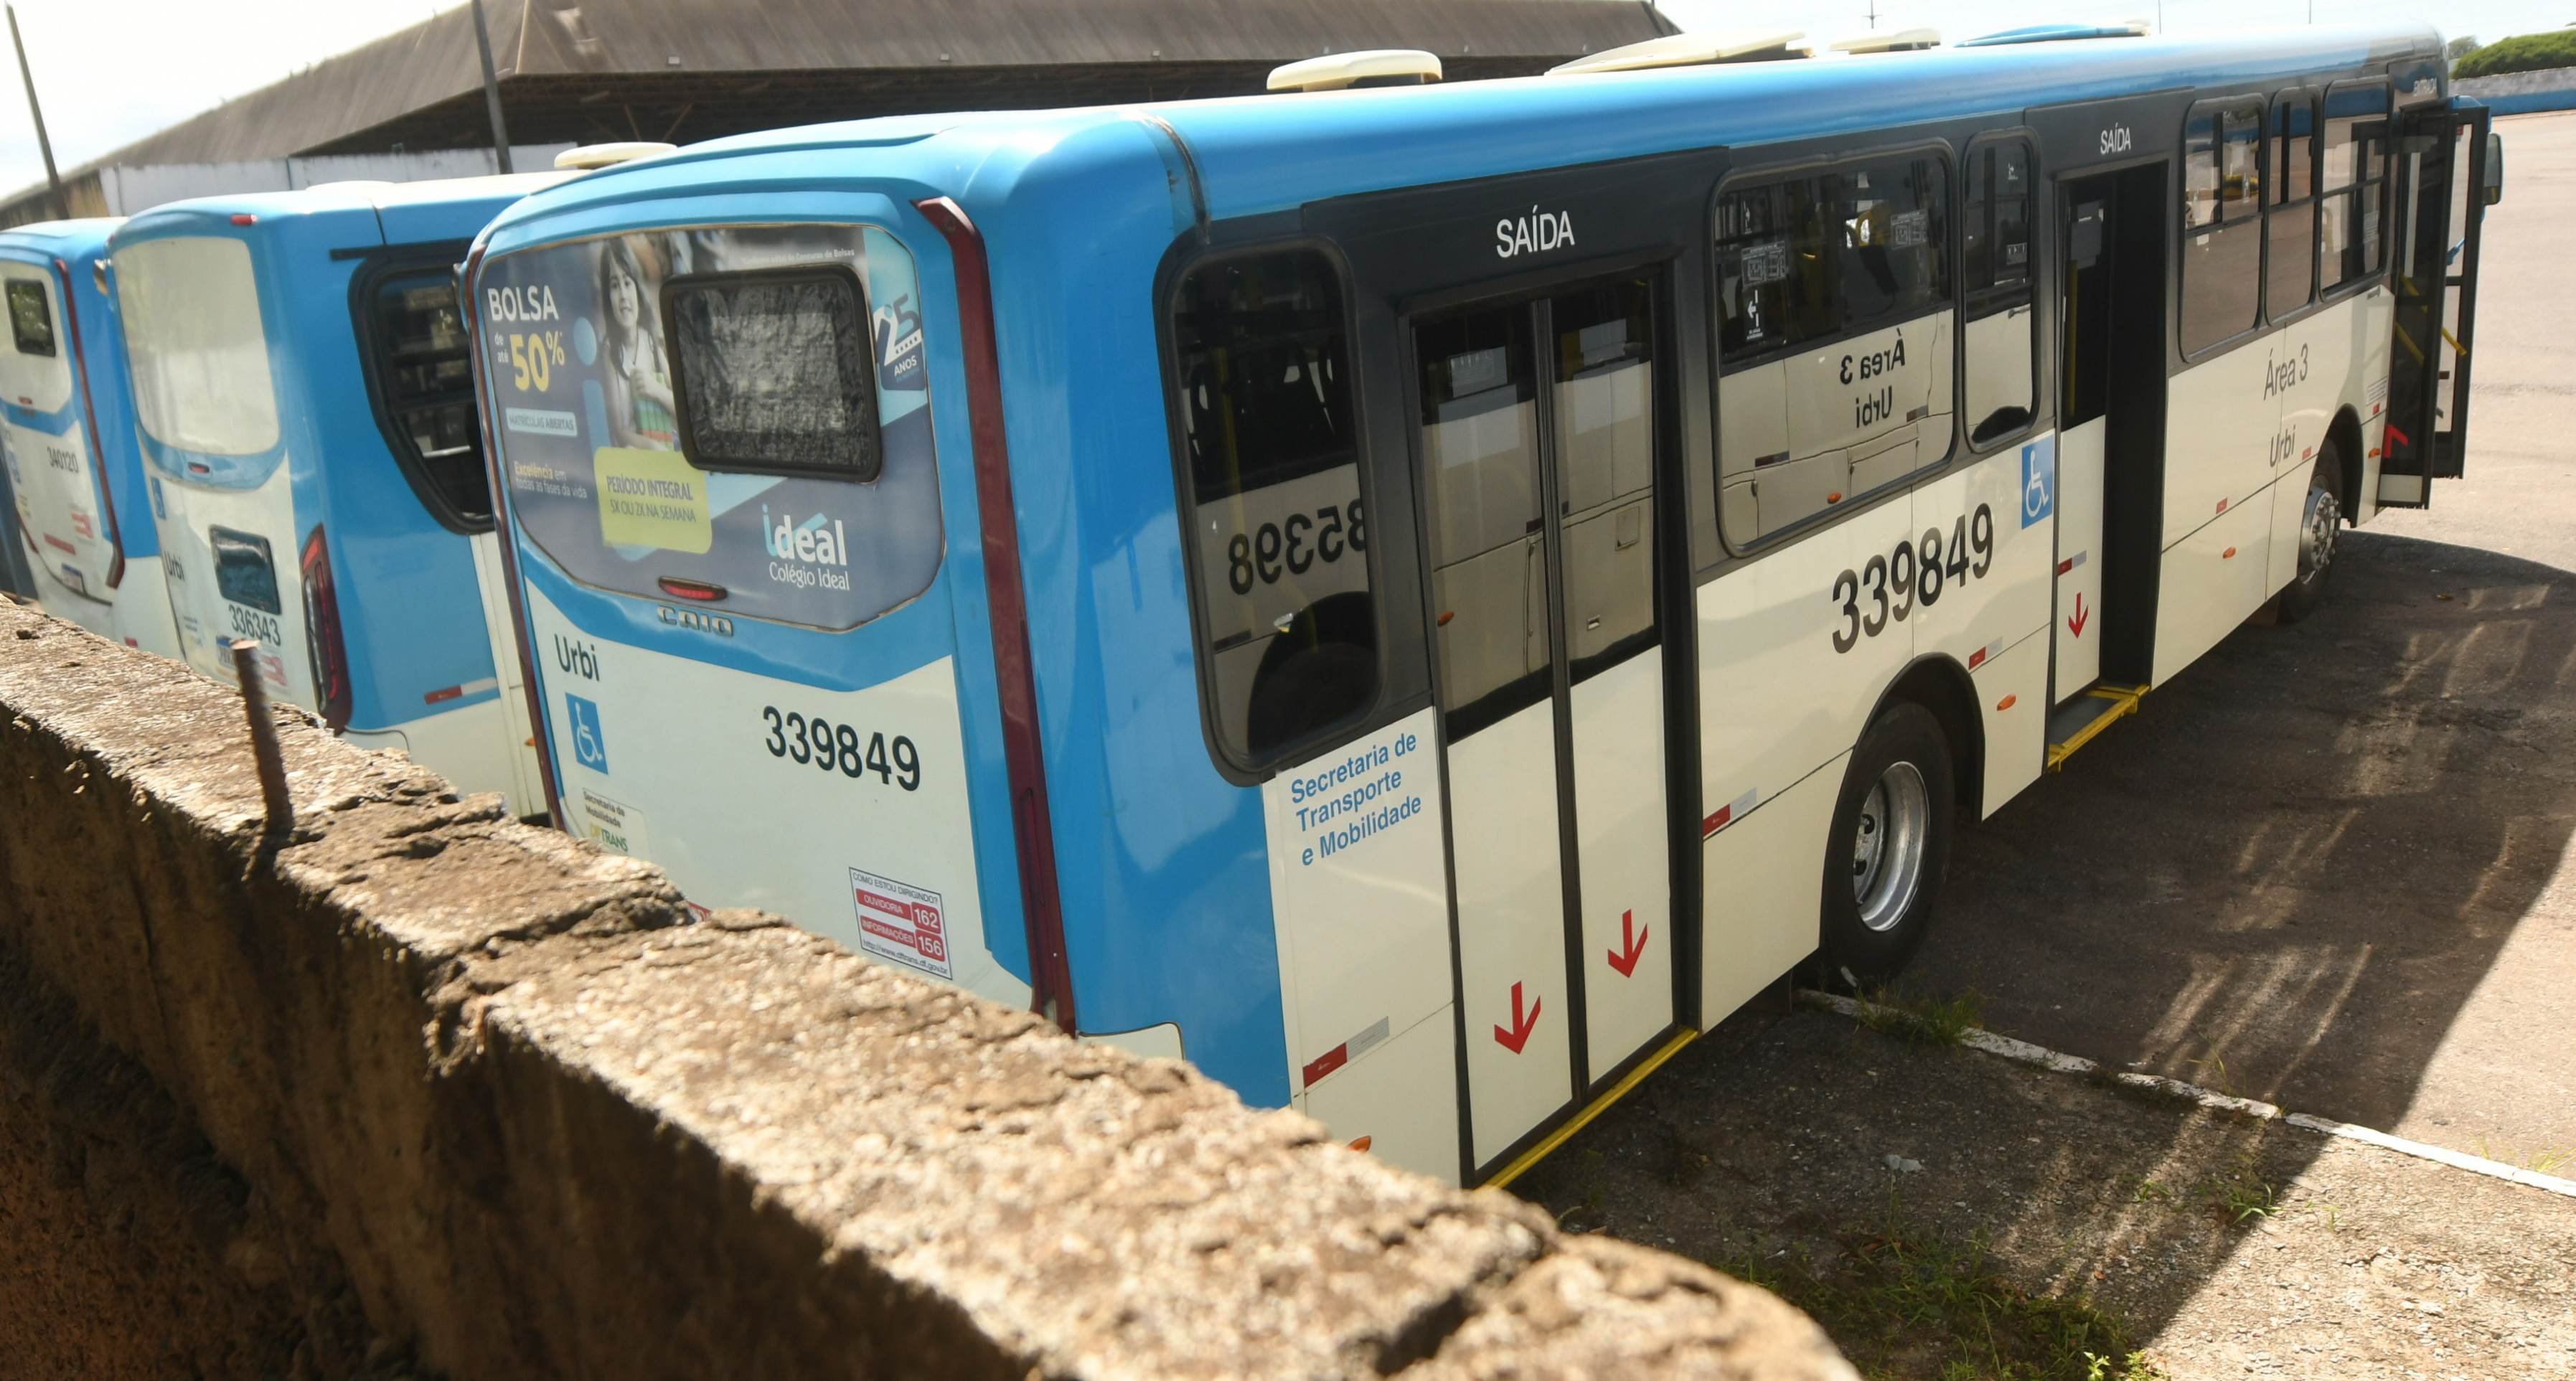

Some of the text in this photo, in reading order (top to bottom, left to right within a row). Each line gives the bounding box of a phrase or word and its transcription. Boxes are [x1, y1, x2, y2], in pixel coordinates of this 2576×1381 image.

[2100, 122, 2131, 155] SAÍDA
[1496, 204, 1575, 258] SAÍDA
[834, 248, 855, 258] Bolsas
[487, 285, 559, 321] BOLSA
[494, 331, 504, 346] de
[497, 349, 509, 363] até
[894, 355, 918, 377] ANOS
[2263, 343, 2308, 402] Área 3
[545, 418, 574, 431] ABERTAS
[46, 446, 79, 473] 340120
[2269, 424, 2296, 468] Urbi
[606, 473, 694, 501] PERÍODO INTEGRAL
[622, 499, 634, 514] OU
[647, 504, 659, 518] NA
[662, 504, 697, 523] SEMANA
[762, 504, 847, 566] ideal
[164, 550, 185, 582] Urbi
[768, 562, 850, 591] Colégio Ideal
[1832, 503, 1993, 654] 339849
[228, 603, 281, 646] 336343
[657, 605, 734, 638] CAIO
[554, 633, 601, 682] Urbi
[763, 705, 921, 791] 339849
[1292, 733, 1416, 803] Secretaria de
[583, 791, 625, 817] Secretaria de
[585, 804, 621, 829] Mobilidade
[1296, 771, 1401, 832] Transporte
[1302, 796, 1421, 866] e Mobilidade
[853, 872, 939, 904] COMO ESTOU DIRIGINDO?
[863, 895, 904, 915] OUVIDORIA
[914, 908, 939, 929] 162
[862, 919, 913, 944] INFORMAÇÕES
[918, 935, 943, 956] 156
[862, 939, 948, 974] http://www.dftrans.df.gov.br
